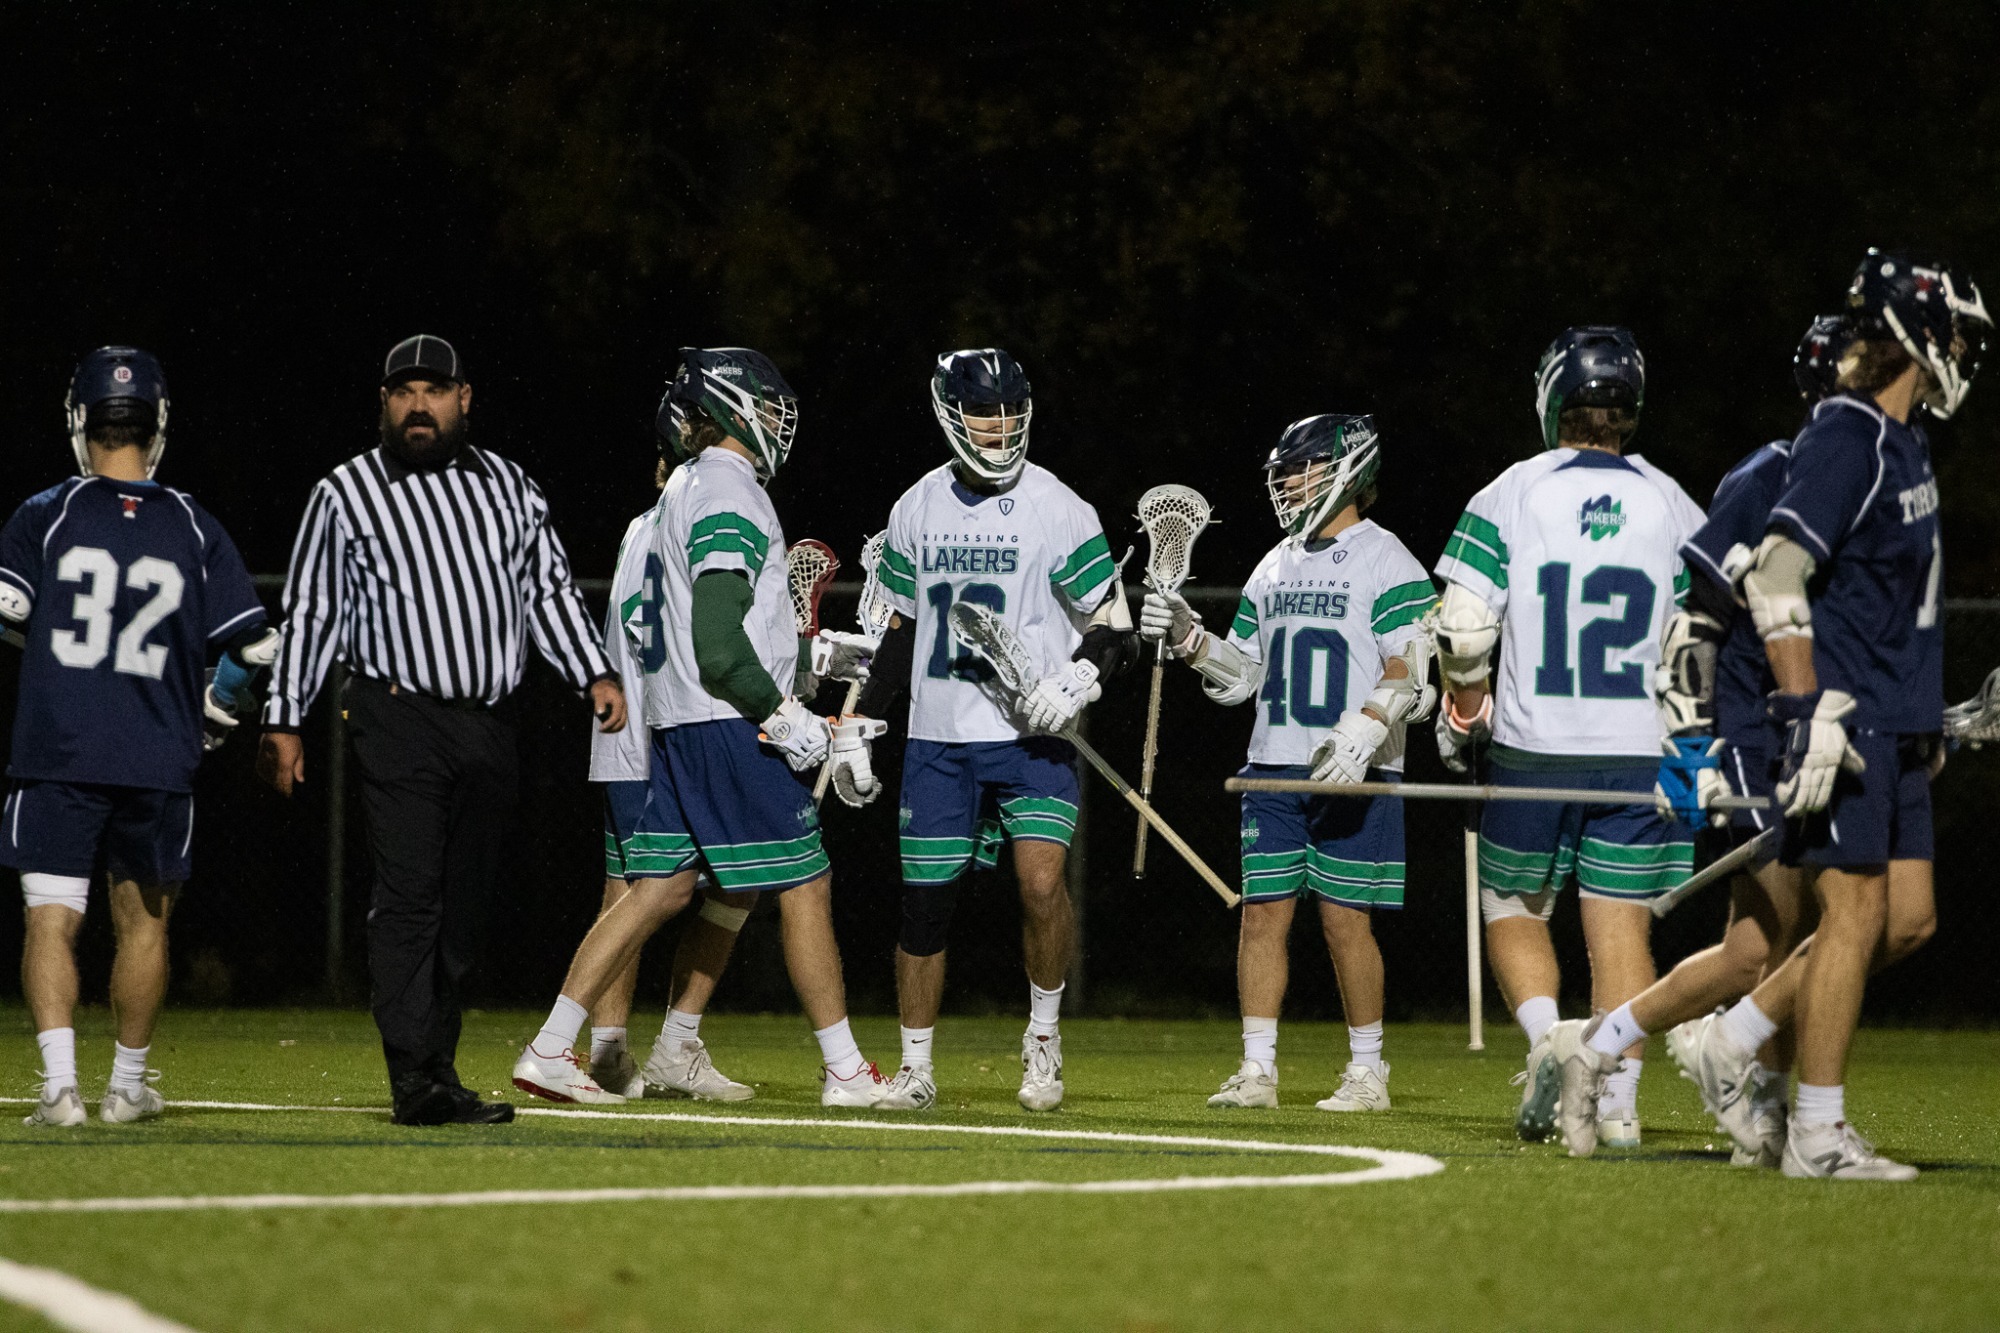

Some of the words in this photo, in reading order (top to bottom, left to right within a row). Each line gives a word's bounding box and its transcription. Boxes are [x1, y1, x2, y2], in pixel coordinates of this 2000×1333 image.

[1576, 510, 1627, 526] LAKERS
[923, 533, 1019, 543] NIPISSING
[921, 545, 1019, 575] LAKERS
[51, 546, 185, 680] 32
[1263, 590, 1351, 621] LAKERS
[1534, 560, 1657, 700] 12
[1260, 626, 1350, 729] 40
